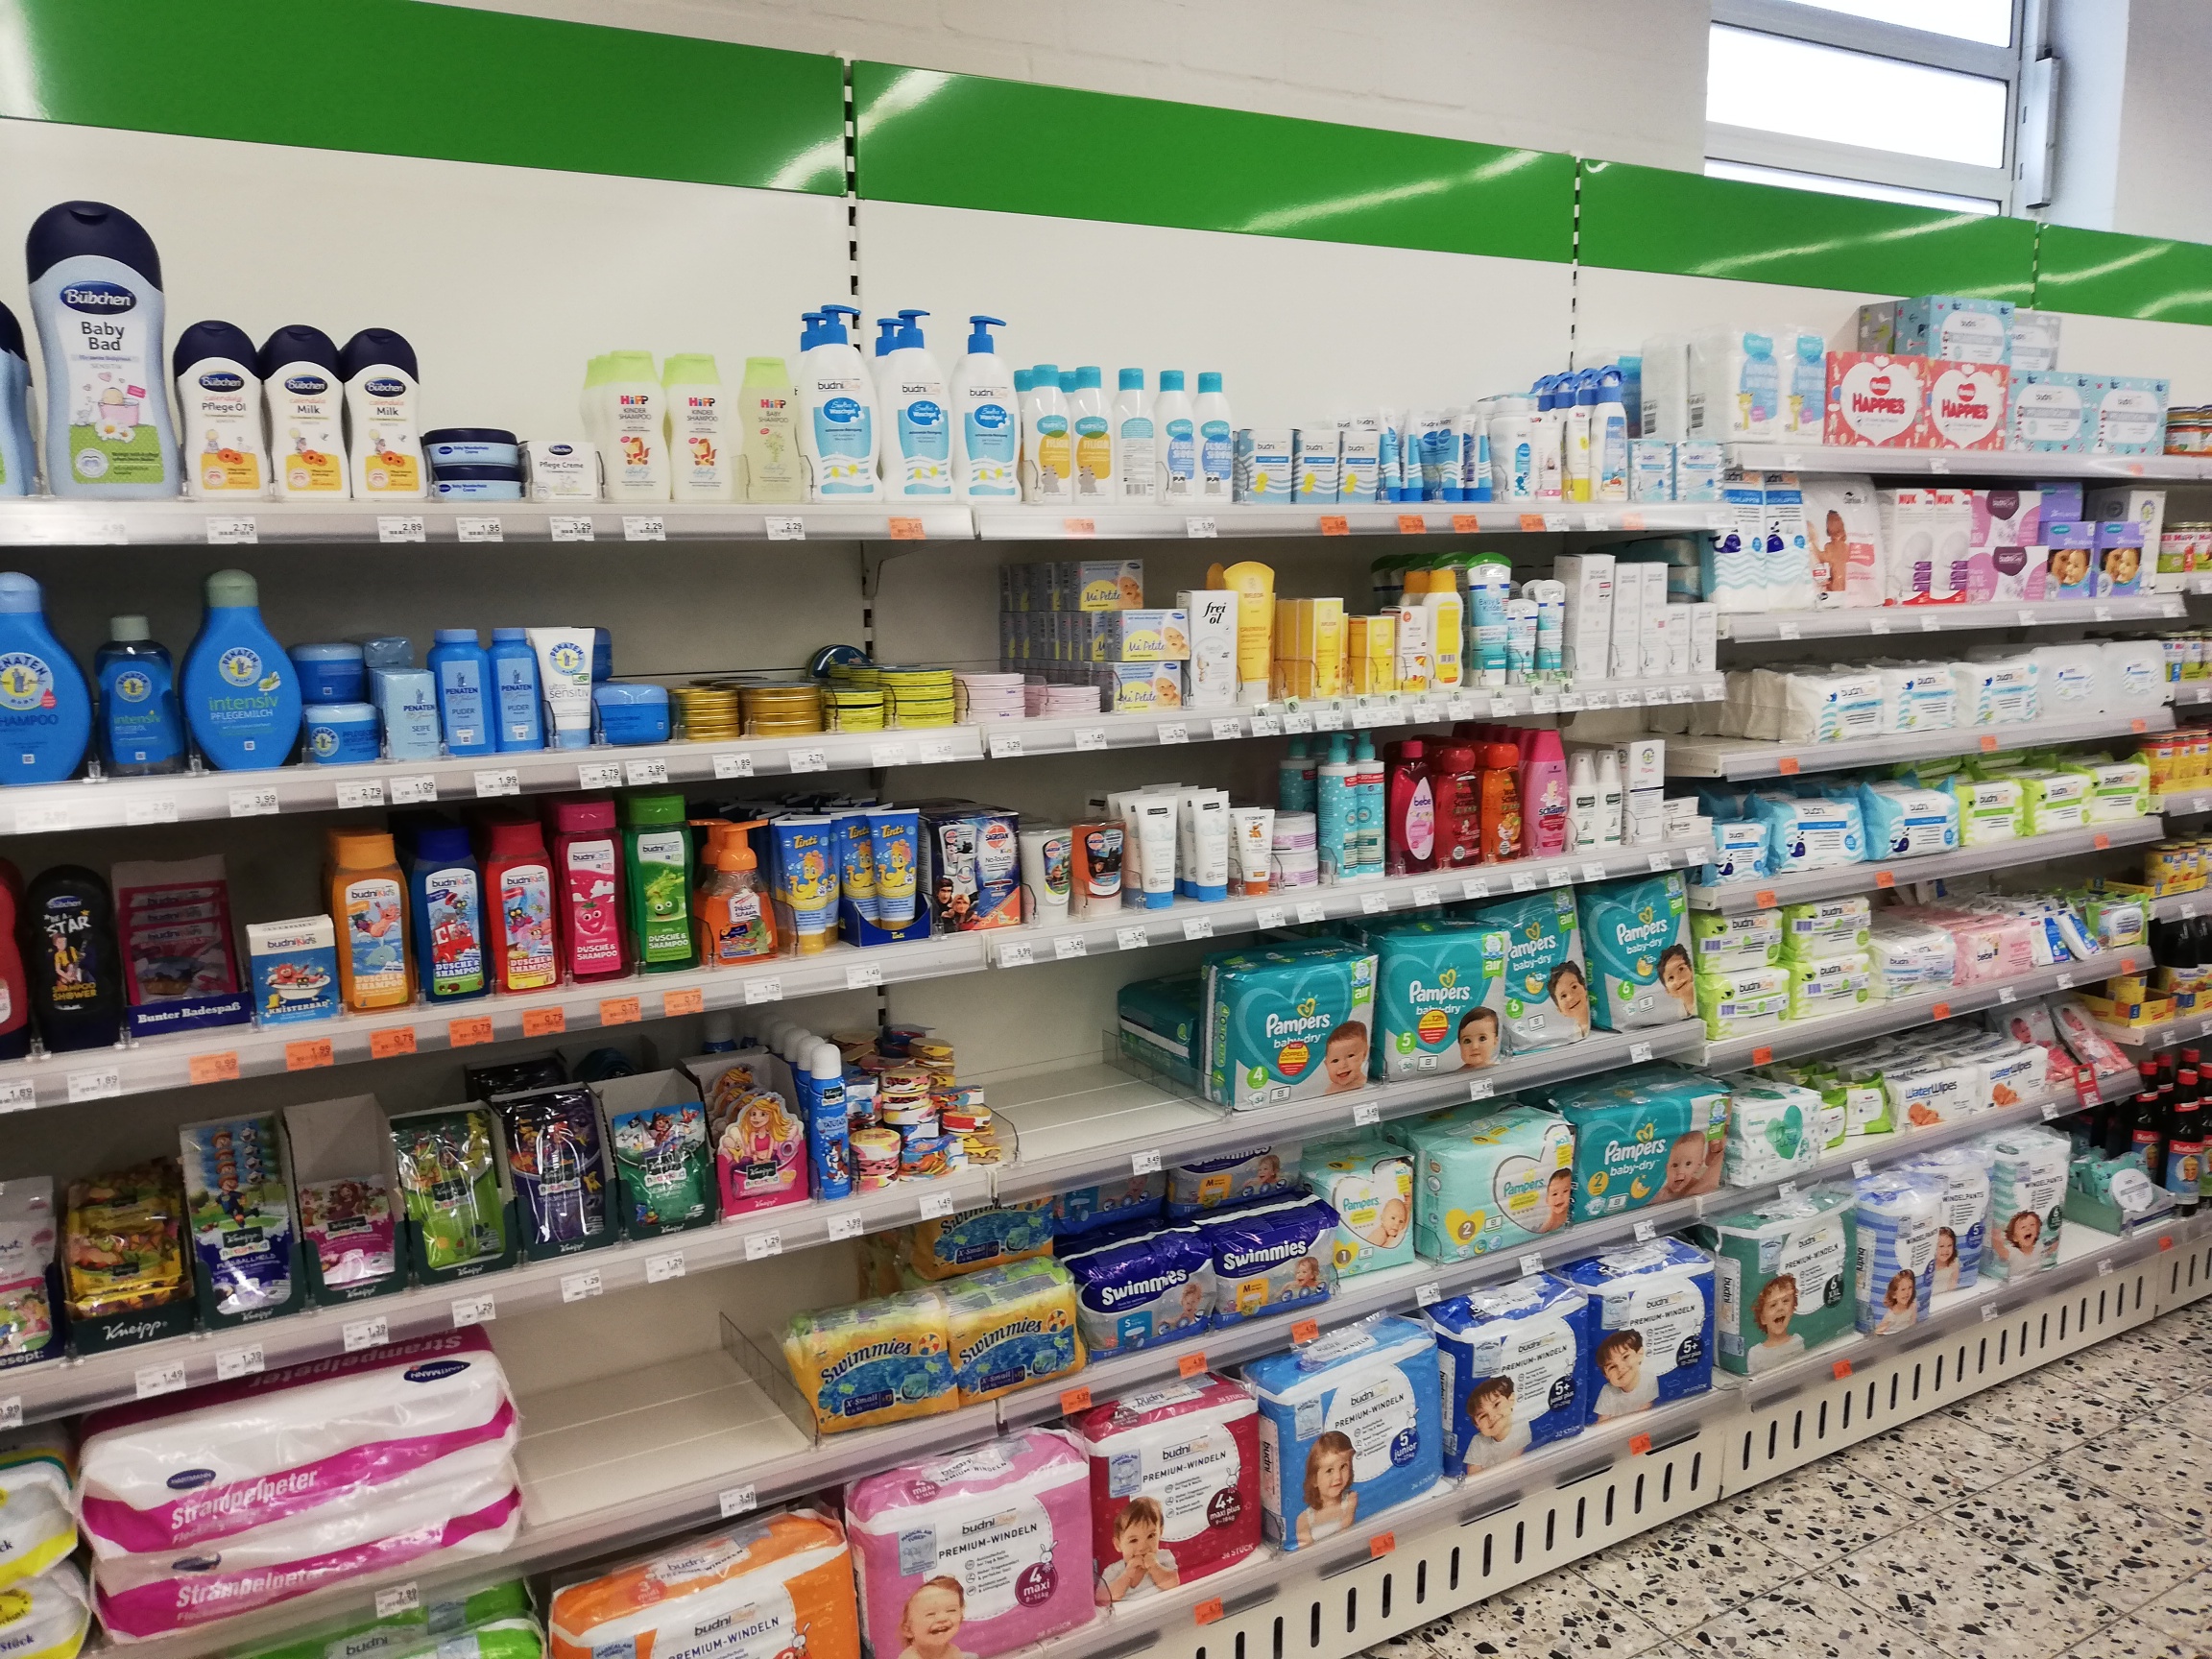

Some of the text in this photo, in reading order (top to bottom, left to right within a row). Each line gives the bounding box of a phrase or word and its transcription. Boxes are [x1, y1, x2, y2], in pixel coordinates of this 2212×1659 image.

[65, 288, 131, 306] Bübchen
[81, 322, 125, 340] Baby
[88, 338, 121, 351] Bad
[202, 376, 241, 389] Bübchen
[287, 380, 325, 391] Bübchen
[366, 382, 405, 394] Bübchen
[620, 396, 649, 405] HiPP
[688, 397, 715, 407] HiPP
[760, 398, 786, 408] HiPP
[1853, 393, 1905, 415] HAPPIES
[202, 402, 229, 413] Pflege
[298, 404, 321, 415] Milk
[376, 406, 399, 417] Milk
[1941, 398, 1989, 420] HAPPIES
[757, 415, 789, 424] SHAMPOO
[233, 523, 254, 532] 2.79
[402, 523, 422, 532] 2.89
[573, 522, 591, 531] 3.29
[1100, 589, 1121, 601] Petite
[1202, 601, 1227, 618] frei
[1209, 613, 1221, 624] öl
[549, 641, 584, 659] PENATEN
[1142, 640, 1166, 652] Petite
[222, 648, 260, 668] PENATEN
[549, 683, 567, 691] ultra
[549, 688, 589, 699] sensitiv
[209, 692, 278, 709] intensiv
[114, 710, 161, 724] intensiv
[210, 709, 274, 720] PFLEGEMILCH
[601, 768, 619, 777] 2.79
[1414, 797, 1431, 806] bebe
[881, 825, 904, 838] Tinti
[793, 835, 818, 850] Tinti
[432, 878, 472, 888] budniKids
[507, 875, 545, 884] budniKids
[351, 888, 395, 899] budniKids
[1671, 897, 1684, 909] air
[46, 915, 92, 936] STAR
[1560, 913, 1574, 925] air
[648, 934, 680, 943] DUSCHE
[1616, 919, 1668, 946] Pampers
[267, 935, 317, 950] budniKids
[577, 945, 608, 953] DUSCHE
[649, 940, 688, 950] SHAMPOO
[1625, 938, 1662, 955] baby-dry
[577, 950, 618, 960] SHAMPOO
[435, 962, 470, 971] DUSCHE
[510, 959, 544, 968] DUSCHE
[510, 962, 552, 974] SHAMPOO
[1484, 959, 1502, 972] air
[1513, 953, 1552, 972] baby-dry
[436, 966, 480, 977] SHAMPOO
[356, 978, 403, 988] SHAMPOO
[1622, 983, 1630, 995] 6
[1353, 986, 1370, 999] air
[1409, 981, 1471, 1004] Pampers
[269, 1000, 328, 1015] KNISTERBAD
[621, 1003, 638, 1012] 0.79
[1416, 1004, 1461, 1016] baby-dry
[1510, 1000, 1520, 1013] 6
[137, 1002, 241, 1025] Bunter Badespaß
[544, 1014, 563, 1022] 0.79
[472, 1023, 491, 1033] 0.79
[1265, 1013, 1330, 1038] Pampers
[394, 1034, 414, 1043] 0.79
[1401, 1032, 1411, 1046] 5
[311, 1046, 331, 1055] 1.99
[1252, 1067, 1263, 1081] 4
[1990, 1061, 2032, 1080] WaterWipes
[10, 1088, 33, 1099] 1.69
[1905, 1080, 1958, 1099] WaterWipes
[1604, 1138, 1665, 1166] Pampers
[749, 1166, 774, 1176] Kneipp
[1610, 1160, 1655, 1177] baby-dry
[1503, 1178, 1544, 1197] Pampers
[1595, 1173, 1603, 1189] 2
[2025, 1175, 2063, 1189] WINDELPANTS
[1941, 1191, 1984, 1203] WINDELPANTS
[1343, 1196, 1379, 1212] Pampers
[661, 1224, 685, 1234] Kneipp
[1462, 1221, 1473, 1237] 2
[1973, 1226, 1979, 1235] 5
[560, 1242, 586, 1252] Kneipp
[1223, 1240, 1307, 1270] Swimmies
[1341, 1250, 1347, 1262] 1
[1785, 1244, 1839, 1269] PREMIUM-WINDELN
[667, 1259, 683, 1267] 1.29
[457, 1265, 483, 1277] Kneipp
[1102, 1267, 1187, 1306] Swimmies
[1830, 1279, 1839, 1289] 6
[346, 1286, 376, 1298] Kneipp
[241, 1309, 274, 1321] Kneipp
[1629, 1305, 1695, 1327] PREMIUM-WINDELN
[103, 1323, 161, 1340] Kneipp
[959, 1316, 1043, 1365] Swimmies
[1684, 1342, 1698, 1354] 5+
[821, 1338, 912, 1384] Swimmies
[1502, 1345, 1567, 1373] PREMIUM-WINDELN
[162, 1370, 183, 1382] 1.49
[981, 1371, 1011, 1385] X-Small
[1554, 1381, 1571, 1396] 5+
[845, 1393, 878, 1408] X-Small
[1334, 1393, 1405, 1429] PREMIUM-WINDELN
[1400, 1431, 1409, 1445] 5
[1394, 1441, 1418, 1461] junior
[1142, 1451, 1227, 1482] PREMIUM-WINDELN
[171, 1468, 318, 1531] Strampelpeter
[1214, 1494, 1235, 1509] 4+
[1210, 1503, 1241, 1521] maxi plus
[939, 1523, 1038, 1559] PREMIUM-WINDELN
[1029, 1569, 1043, 1582] 4
[1023, 1578, 1050, 1596] maxi
[668, 1616, 780, 1659] PREMIUM-WINDELN
